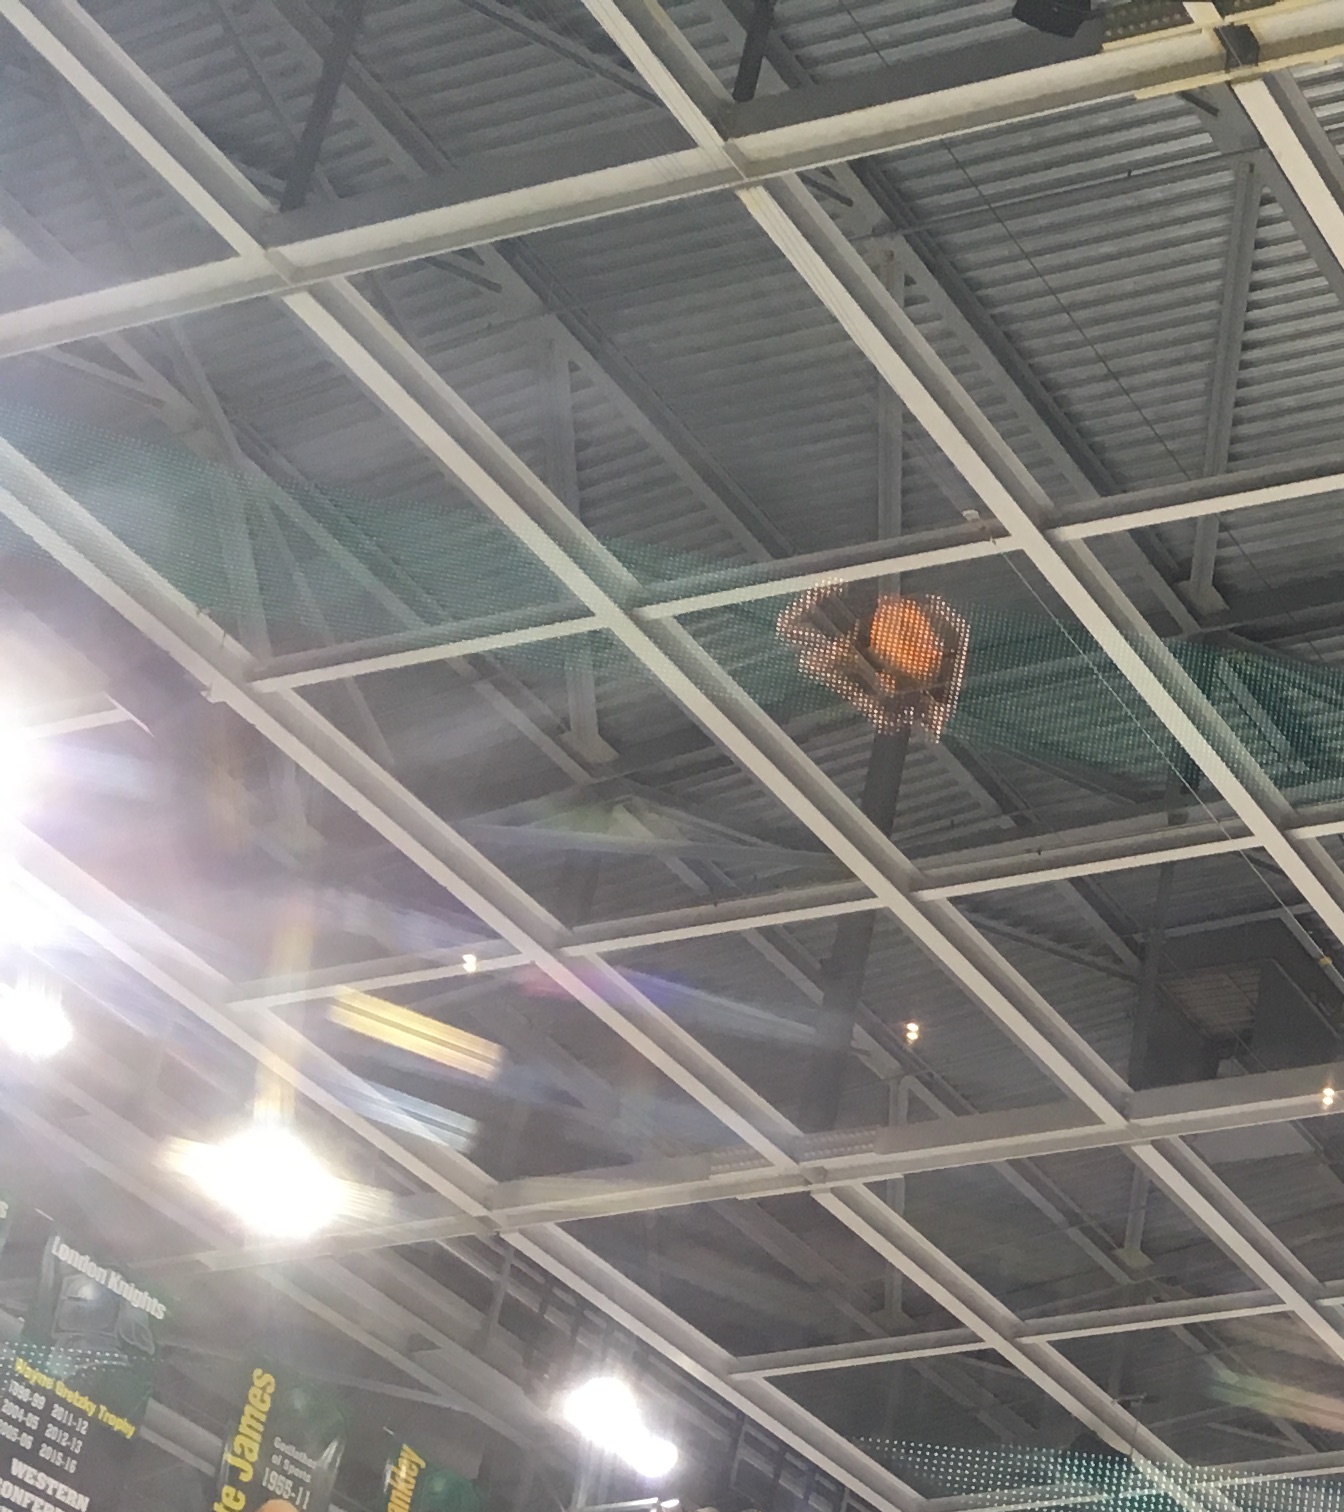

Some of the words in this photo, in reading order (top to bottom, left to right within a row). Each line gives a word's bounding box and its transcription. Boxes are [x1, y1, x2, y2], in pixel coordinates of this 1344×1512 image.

[51, 1235, 108, 1286] London
[106, 1269, 167, 1320] Knights
[99, 1404, 136, 1439] Trophy
[227, 1367, 276, 1483] James
